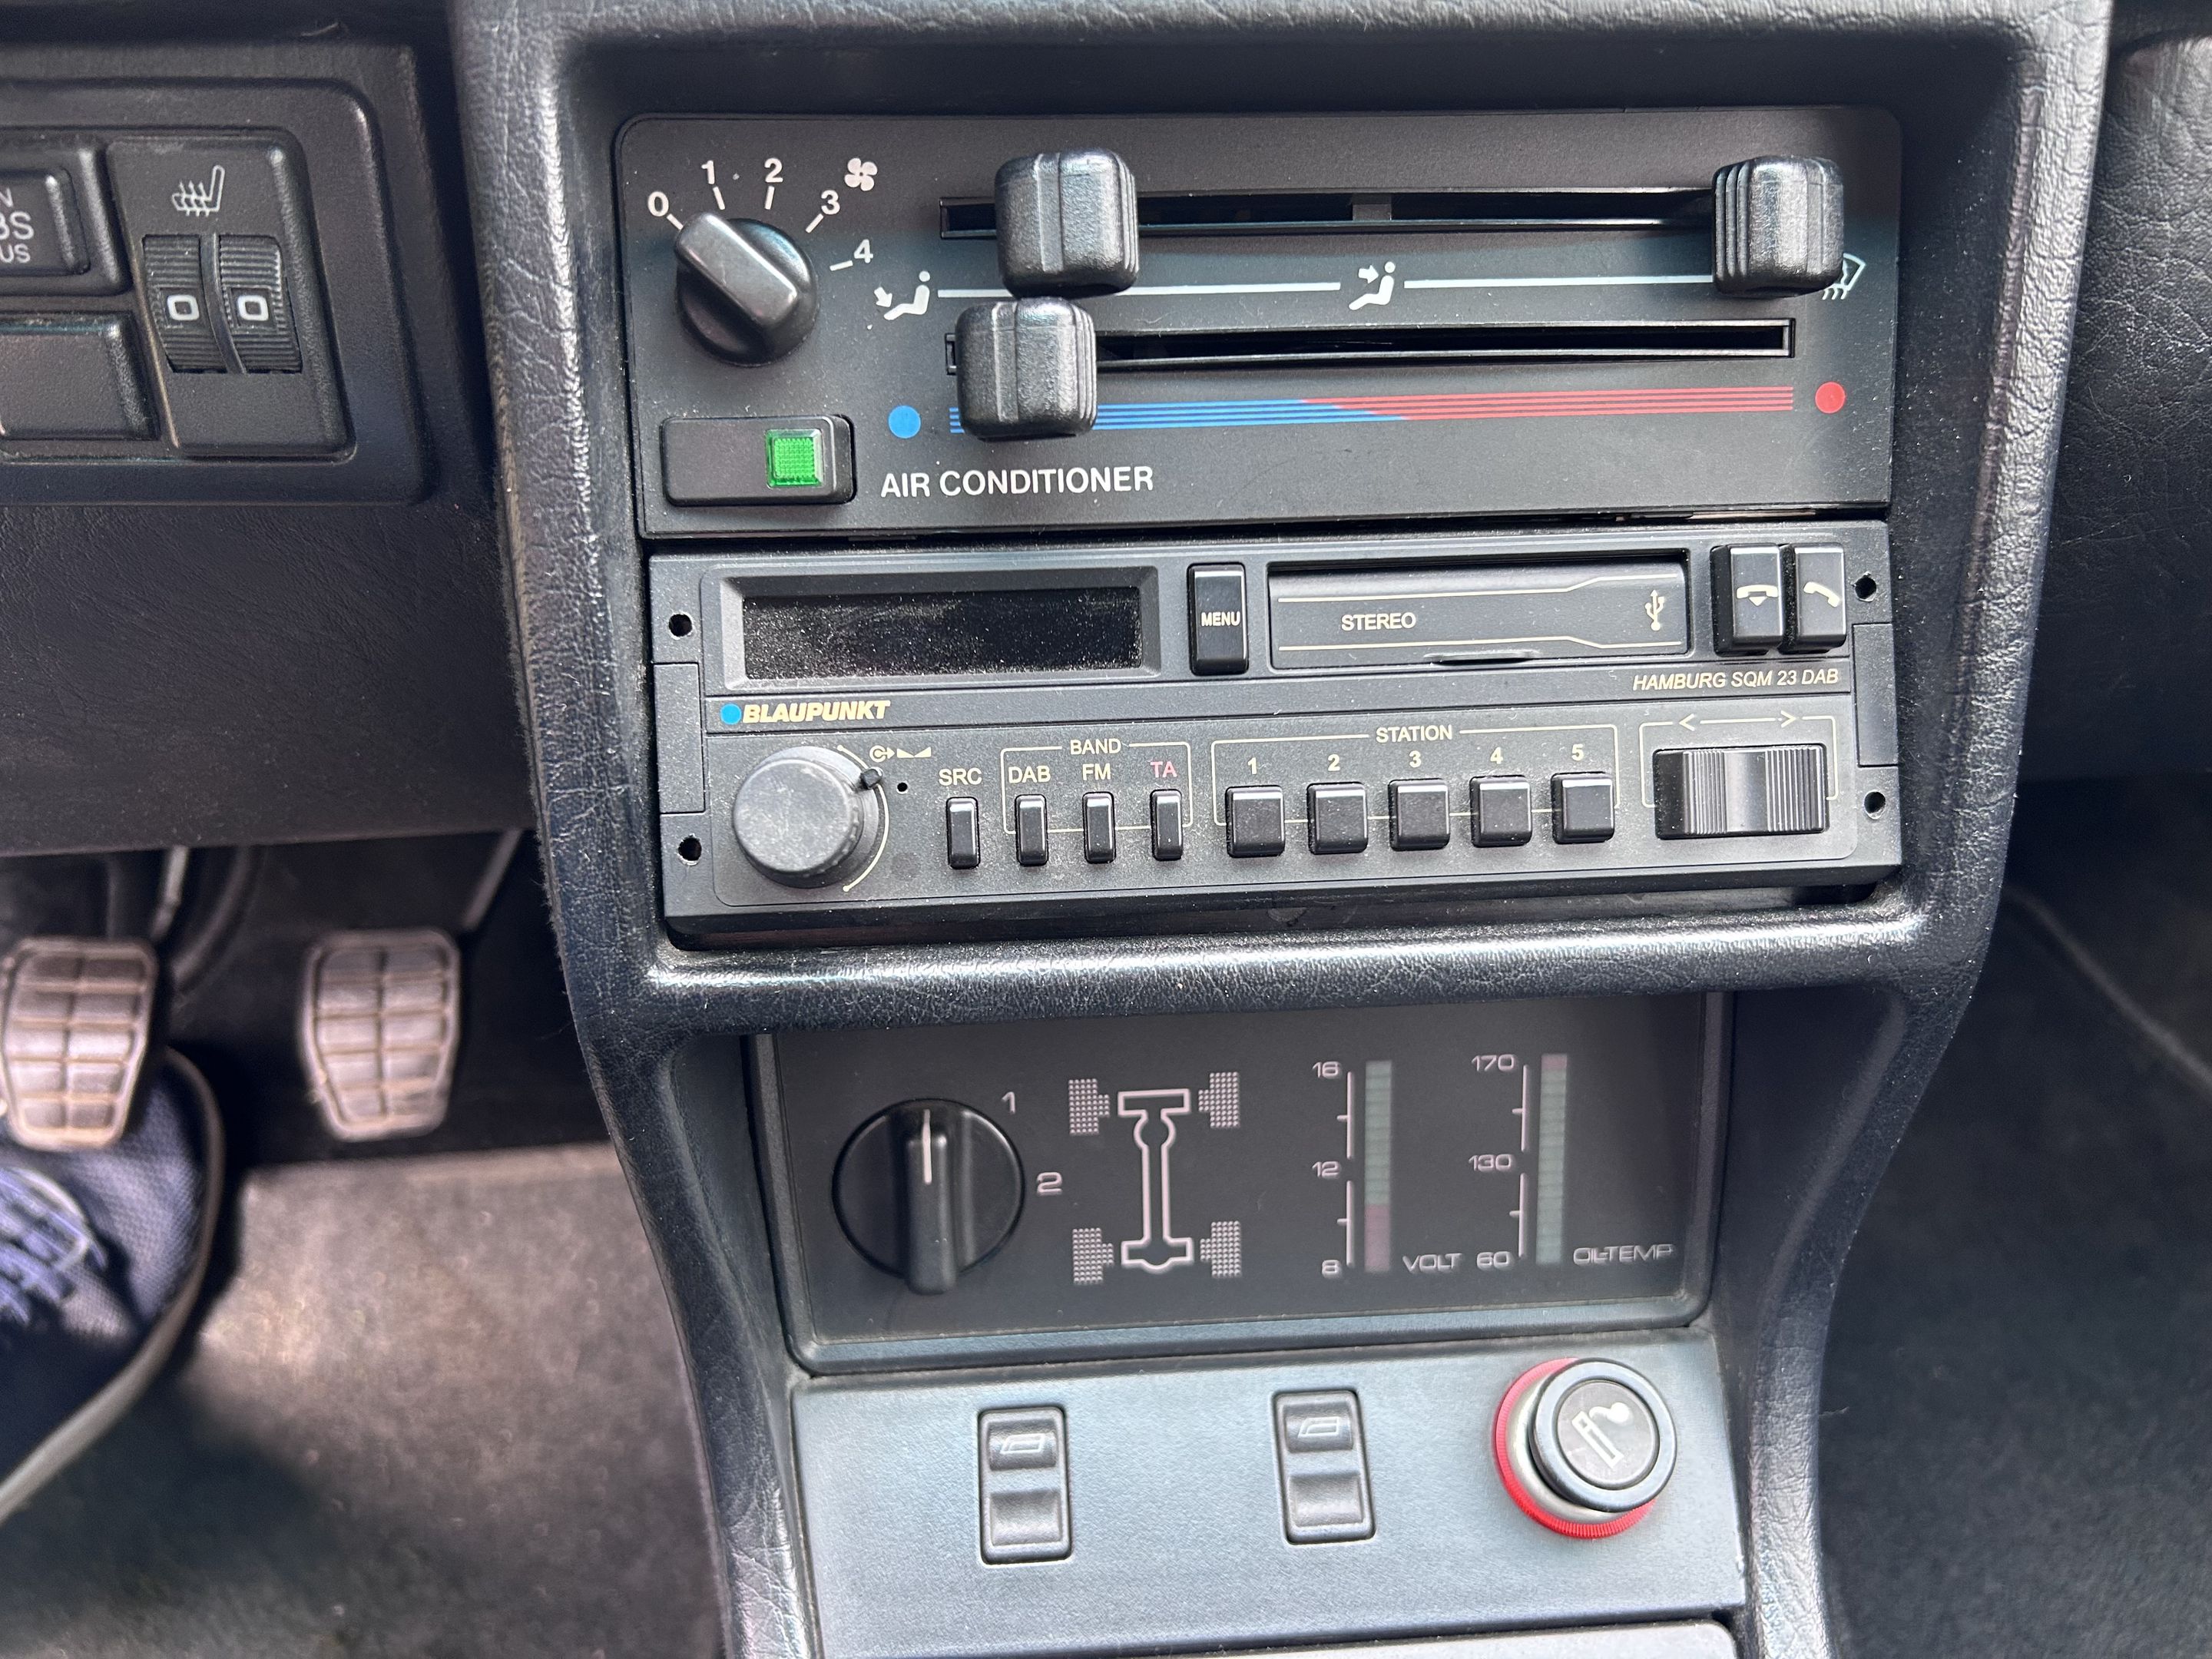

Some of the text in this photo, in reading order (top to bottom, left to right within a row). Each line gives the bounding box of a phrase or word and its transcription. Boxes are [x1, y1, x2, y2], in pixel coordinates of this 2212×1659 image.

[701, 160, 715, 184] 1
[764, 157, 783, 183] 2
[647, 191, 669, 217] 0
[821, 190, 840, 215] 3
[853, 239, 874, 263] 4
[880, 465, 1154, 498] AIR CONDITIONER
[1200, 611, 1240, 627] MENU
[1341, 611, 1417, 631] STEREO
[1632, 668, 1839, 691] HAMBURG SQM 23 DAB
[742, 700, 891, 724] BLAUPUNKT
[1376, 724, 1453, 743] STATION
[1070, 737, 1121, 755] BAND
[1571, 743, 1584, 761] 5
[1327, 753, 1341, 772] 2
[1409, 750, 1422, 768] 3
[1490, 747, 1504, 765] 4
[1008, 765, 1051, 784] DAB
[1082, 763, 1111, 781] FM
[1151, 760, 1177, 779] TA
[1247, 757, 1257, 775] 1
[939, 767, 982, 786] SRC
[1312, 1061, 1339, 1078] 16
[1472, 1054, 1515, 1071] 170
[1002, 1091, 1015, 1113] 1
[1312, 1161, 1339, 1177] 12
[1469, 1154, 1512, 1171] 130
[1037, 1171, 1062, 1194] 2
[1321, 1259, 1340, 1276] 8
[1402, 1253, 1462, 1272] VOLT
[1476, 1250, 1511, 1269] 60
